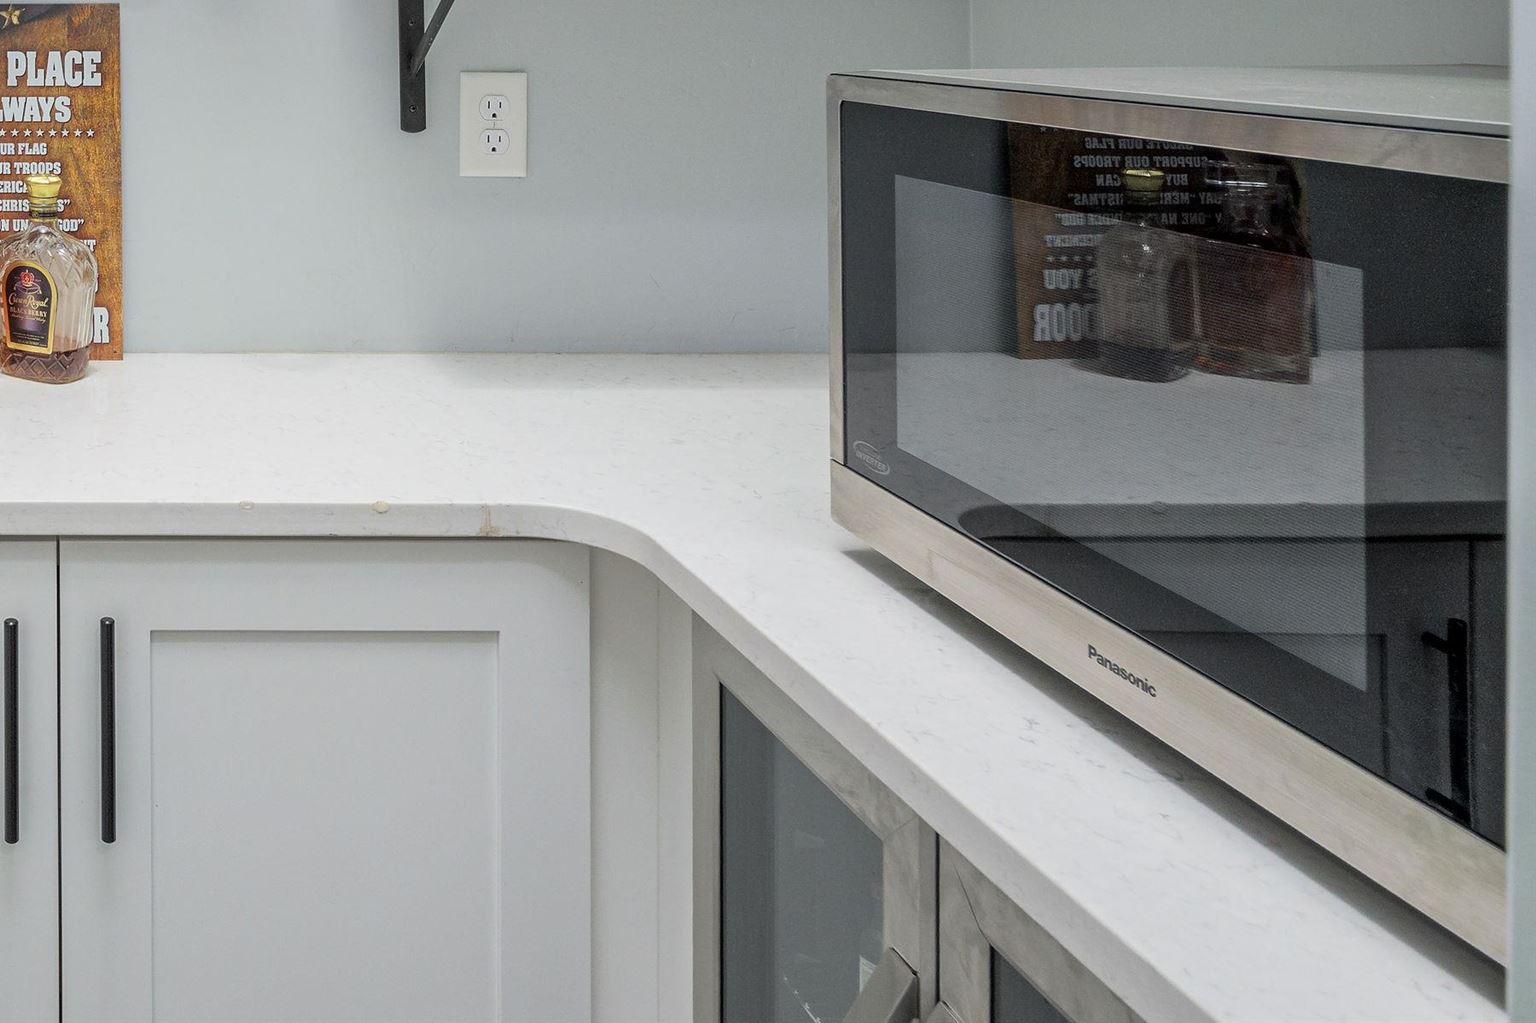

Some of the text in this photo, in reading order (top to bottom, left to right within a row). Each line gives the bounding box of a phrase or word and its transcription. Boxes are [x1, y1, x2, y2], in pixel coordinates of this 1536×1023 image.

[7, 51, 102, 87] PLACE
[18, 143, 48, 156] FLAG
[14, 162, 62, 174] TROOPS
[26, 296, 49, 309] Royal
[1088, 643, 1157, 698] Panasonic
